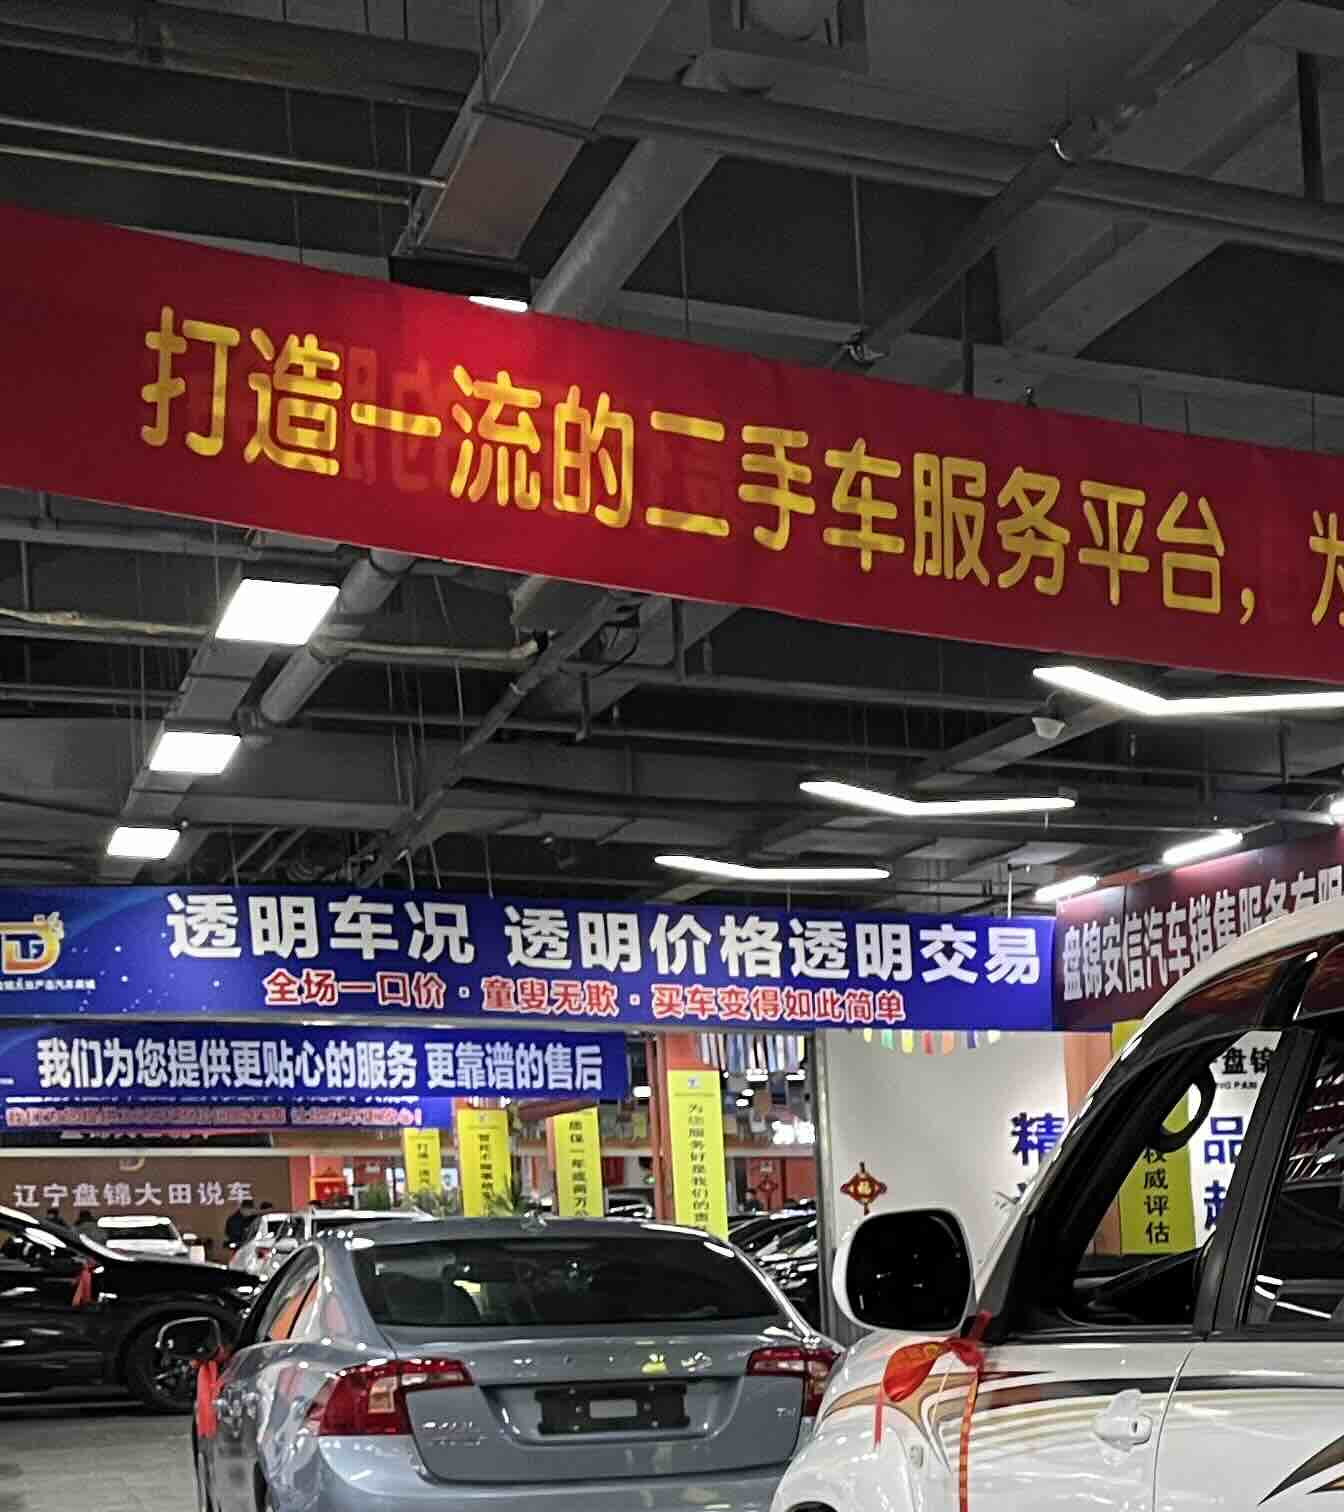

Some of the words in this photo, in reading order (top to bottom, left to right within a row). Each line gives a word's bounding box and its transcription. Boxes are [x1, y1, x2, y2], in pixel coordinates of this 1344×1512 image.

[166, 891, 474, 964] 透明车况
[504, 904, 1041, 987] 透明价格透明交易
[37, 1037, 418, 1089] 我们为您提供更贴心的服务
[423, 1041, 603, 1090] 更靠谱的售后
[13, 1182, 254, 1208] 辽宁盘锦大田说车
